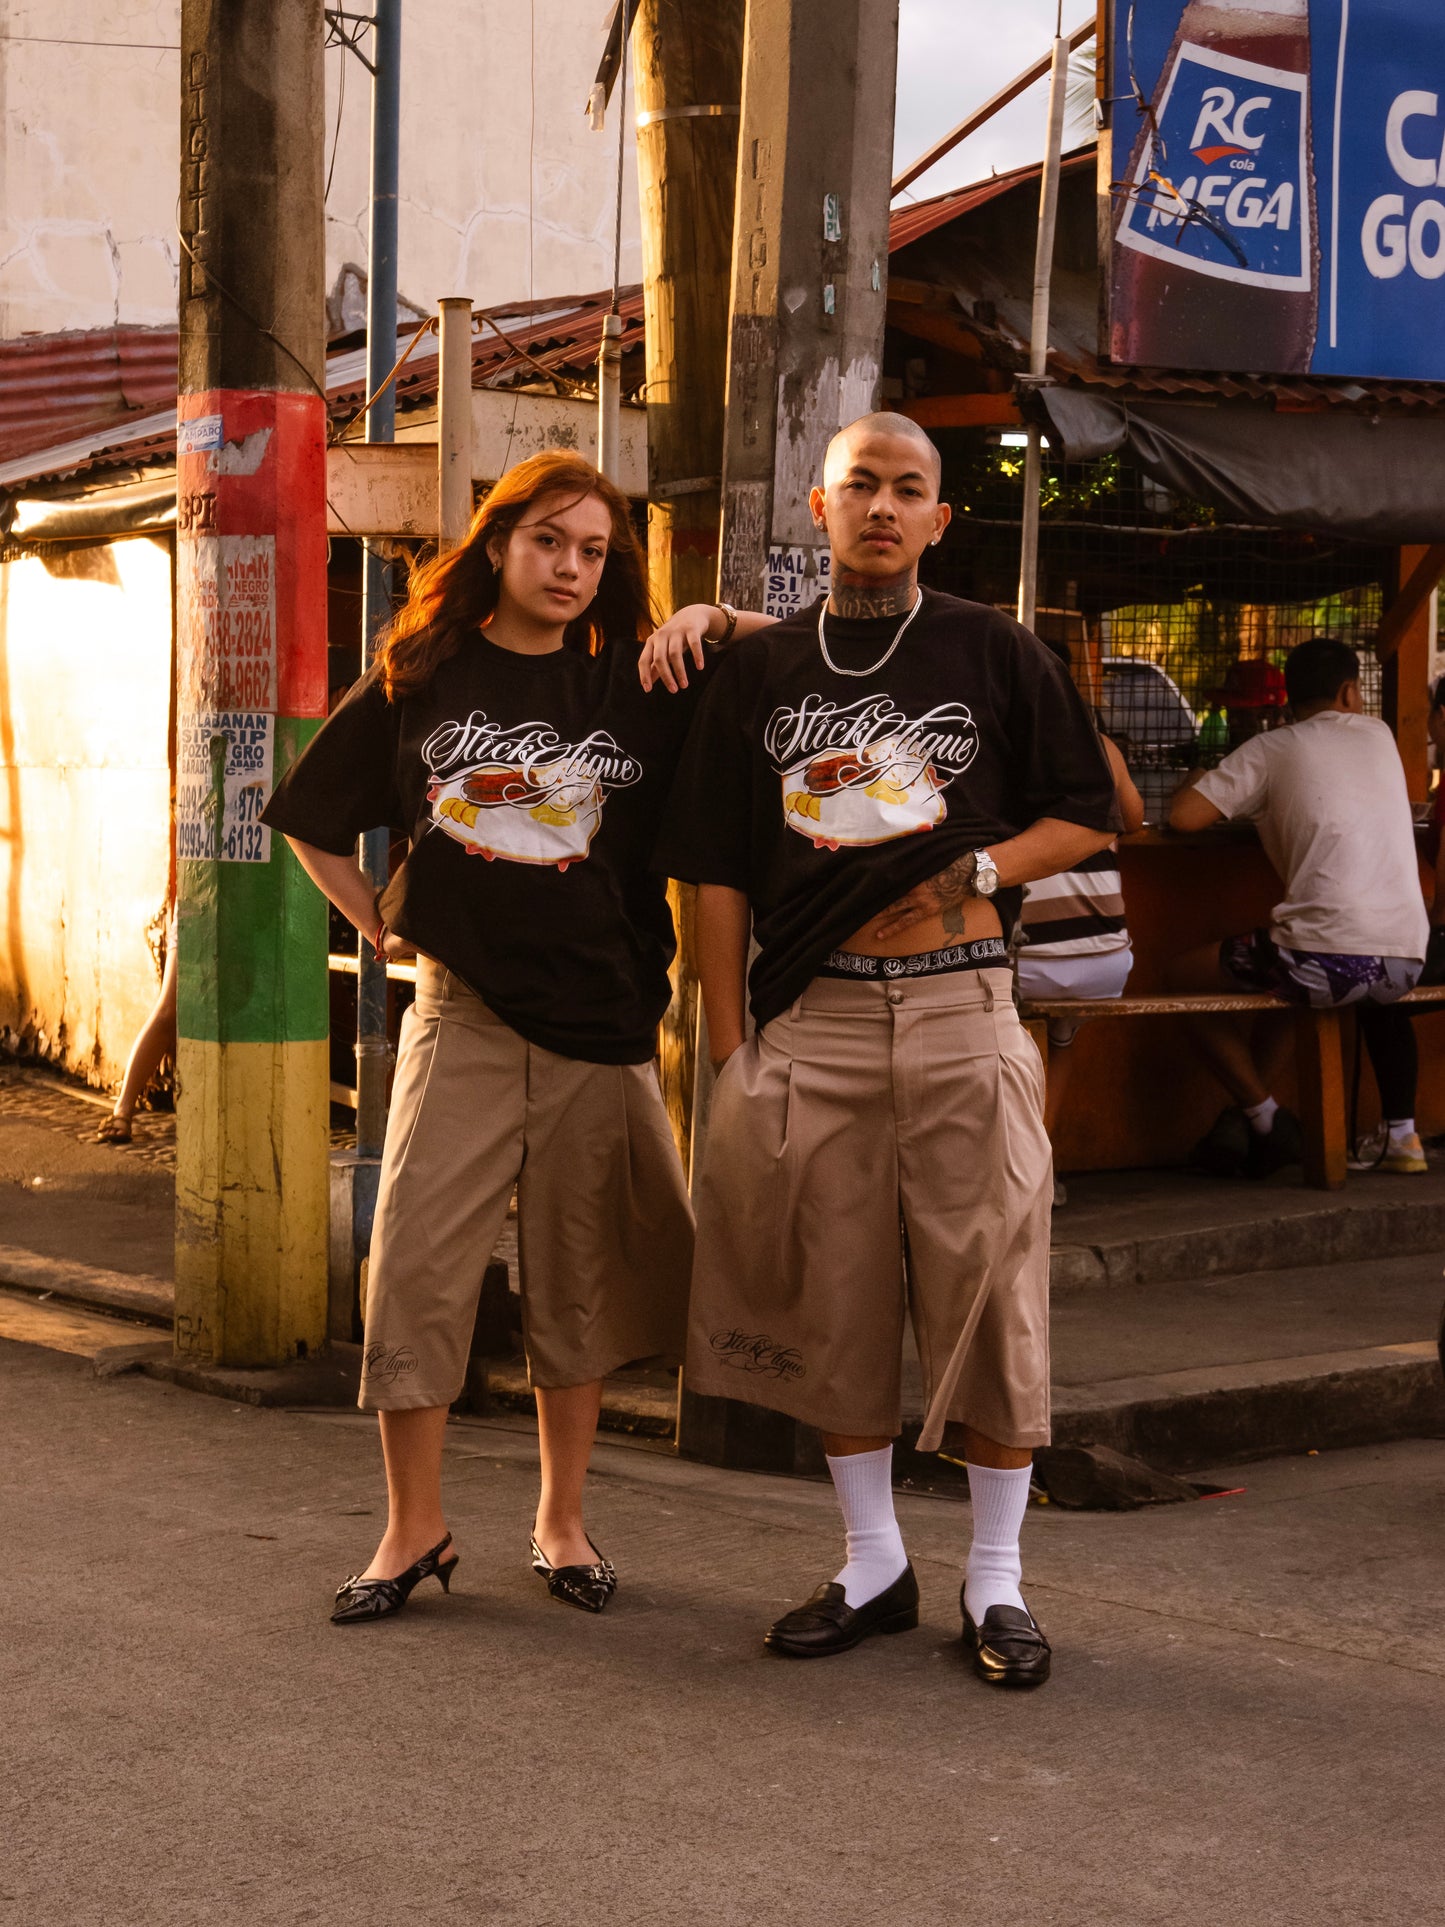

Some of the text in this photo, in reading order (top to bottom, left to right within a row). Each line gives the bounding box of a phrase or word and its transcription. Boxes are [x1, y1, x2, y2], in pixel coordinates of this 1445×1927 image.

[1189, 86, 1271, 150] RC
[1385, 89, 1445, 187] C
[1229, 157, 1256, 171] cola
[1146, 174, 1294, 230] MEGA
[184, 426, 222, 441] AMPARO
[769, 553, 831, 576] MALB
[235, 580, 270, 593] NEGRO
[231, 593, 269, 601] ABABO
[767, 593, 802, 604] POZ
[181, 711, 267, 730] MALABANAN
[182, 744, 265, 760] POZO GRO
[228, 759, 264, 769] ABABO
